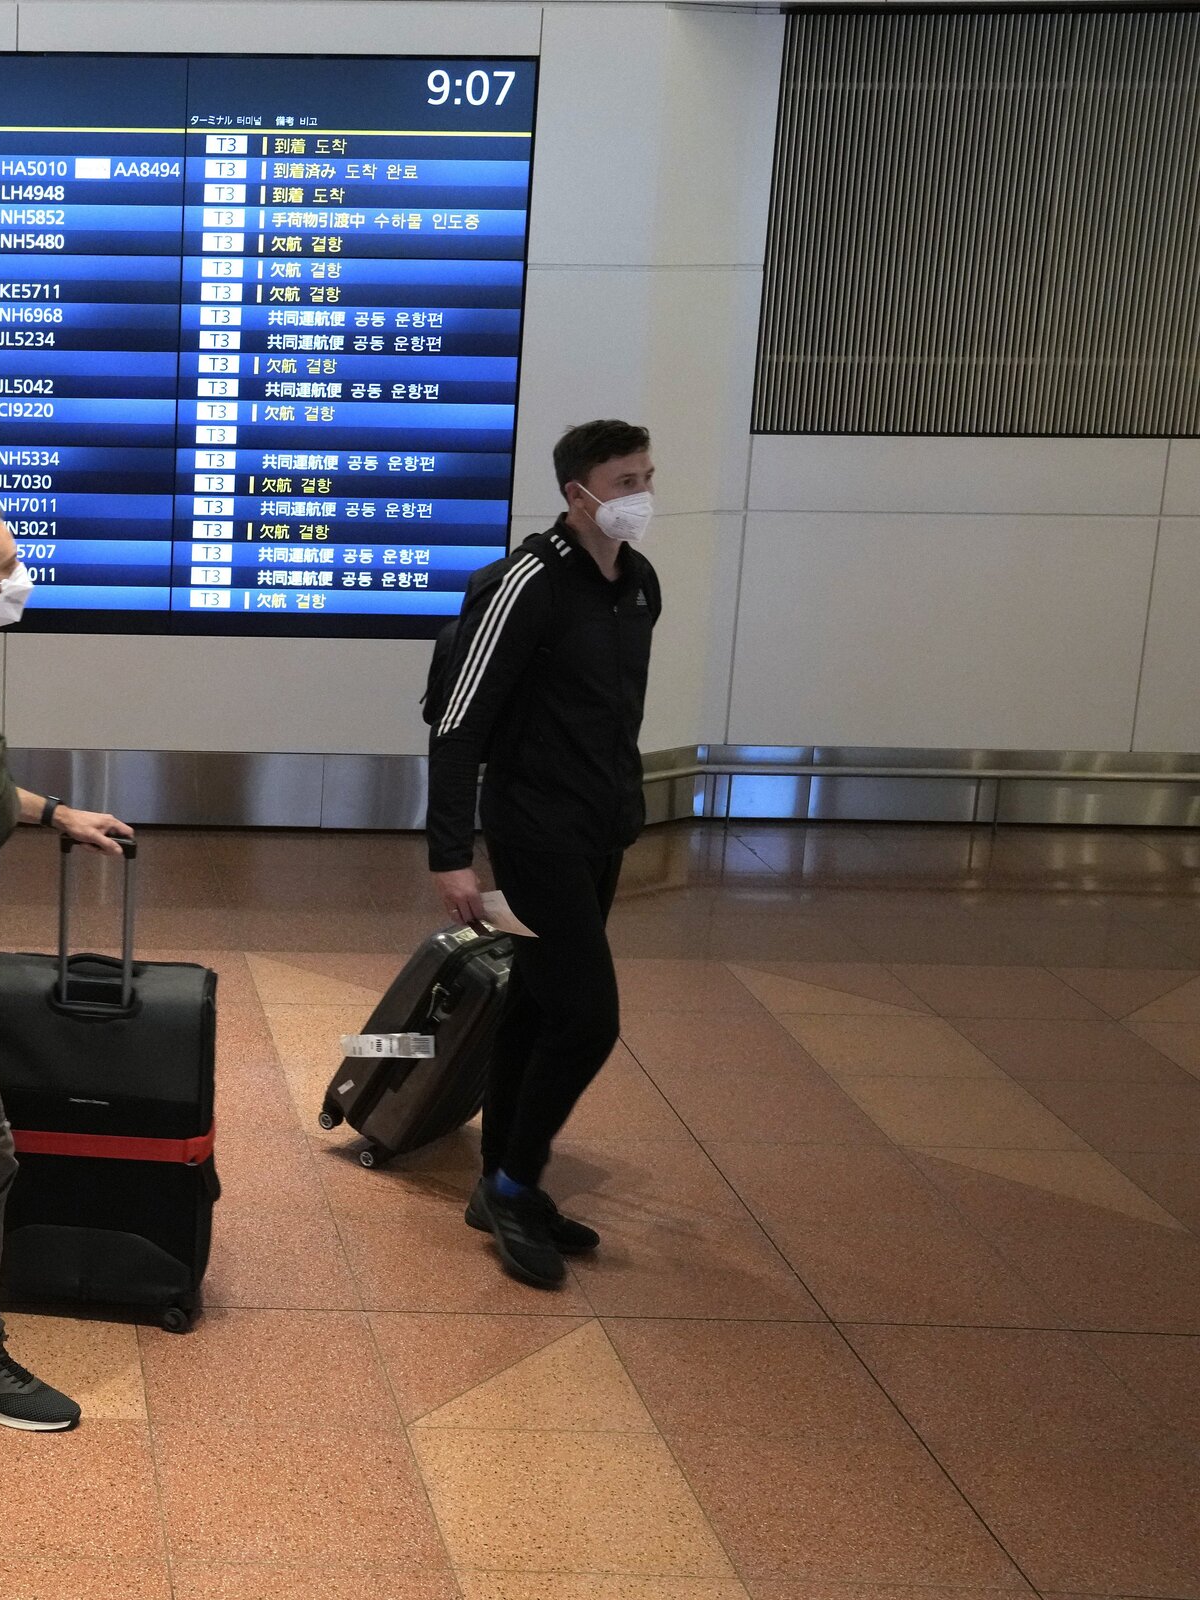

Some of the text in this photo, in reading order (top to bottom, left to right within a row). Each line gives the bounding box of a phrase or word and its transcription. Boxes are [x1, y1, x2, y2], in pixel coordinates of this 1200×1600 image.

[427, 69, 516, 106] 9:07
[190, 115, 262, 126] ターミナル 터미널
[275, 115, 318, 127] 備考 비고
[218, 138, 236, 152] T3
[275, 138, 347, 154] 到着 도착
[2, 161, 67, 176] HA5010
[114, 162, 180, 177] AA8494
[274, 163, 418, 179] 到着済み 도착 완료
[2, 185, 64, 200] LH4948
[273, 187, 345, 203] 到着 도착
[1, 210, 64, 224] NH5852
[272, 212, 479, 229] 手荷物引渡中 수하물 인도중
[1, 234, 64, 249] NH5480
[272, 236, 342, 252] 欠航 결항
[271, 262, 301, 277] 欠航
[0, 284, 59, 298] KE5711
[0, 308, 62, 322] NH6968
[211, 310, 230, 323] T3
[268, 310, 442, 327] 共同運航便 공동 운항편
[211, 334, 229, 348] T3
[267, 334, 344, 350] 共同運航便
[210, 357, 229, 371] T3
[267, 358, 337, 374] 欠航 결항
[265, 382, 438, 399] 共同運航便 공동 운항편
[263, 454, 338, 470] 共同運航便
[262, 478, 332, 493] 欠航 결항
[261, 501, 336, 516] 共同運航便
[4, 521, 56, 536] N3021
[260, 524, 289, 539] 欠航
[16, 544, 56, 559] 5707
[259, 547, 334, 563] 共同運航便
[258, 570, 428, 587] 共同運航便 공동 운항편
[257, 593, 326, 608] 欠航 결항
